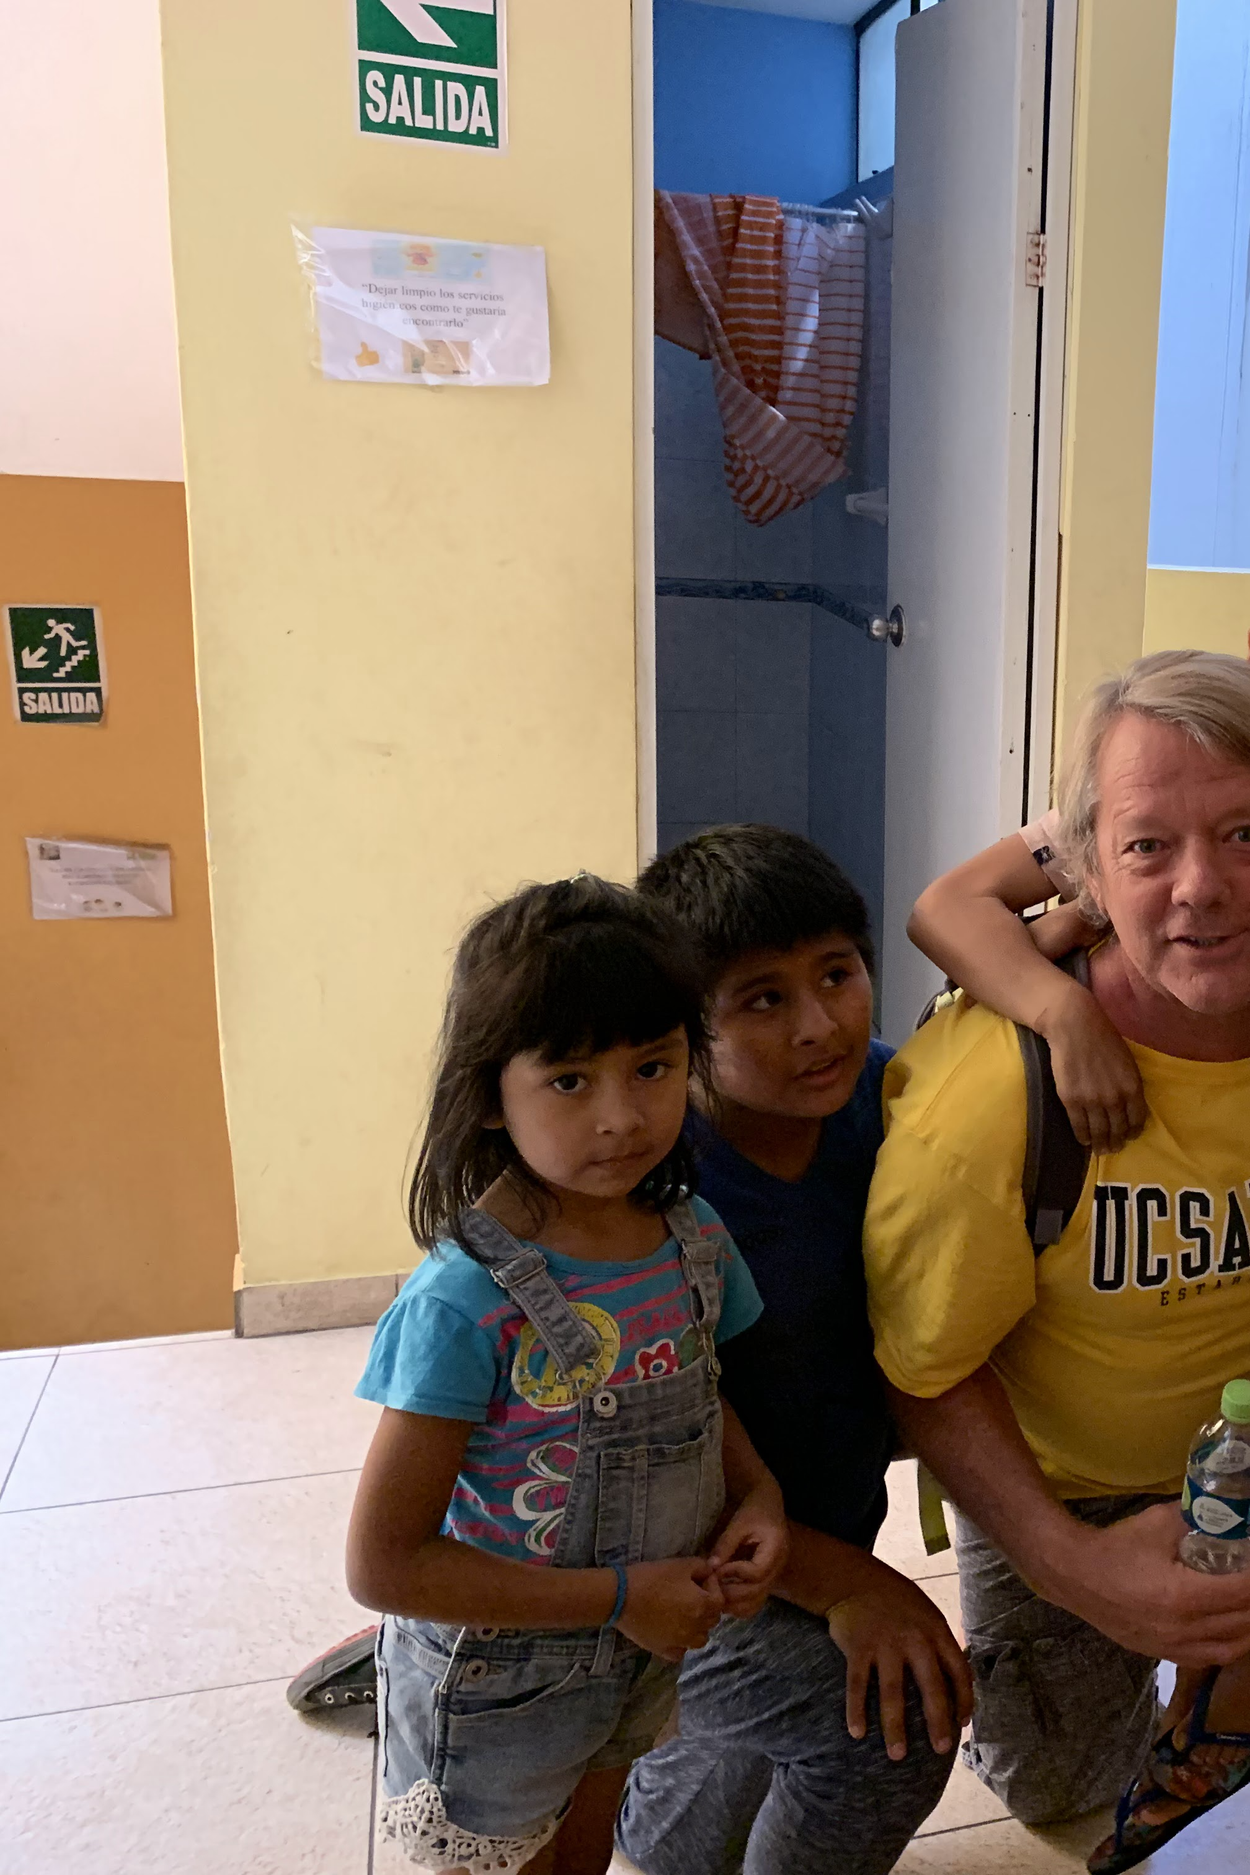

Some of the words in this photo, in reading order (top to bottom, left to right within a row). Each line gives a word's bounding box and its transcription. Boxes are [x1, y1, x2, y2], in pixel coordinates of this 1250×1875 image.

[365, 70, 493, 137] SALIDA
[401, 285, 436, 299] limpio
[439, 289, 454, 299] los
[458, 290, 504, 302] servicios
[362, 298, 417, 311] higiéncos
[420, 304, 450, 313] como
[453, 304, 462, 314] te
[22, 692, 100, 714] SALIDA
